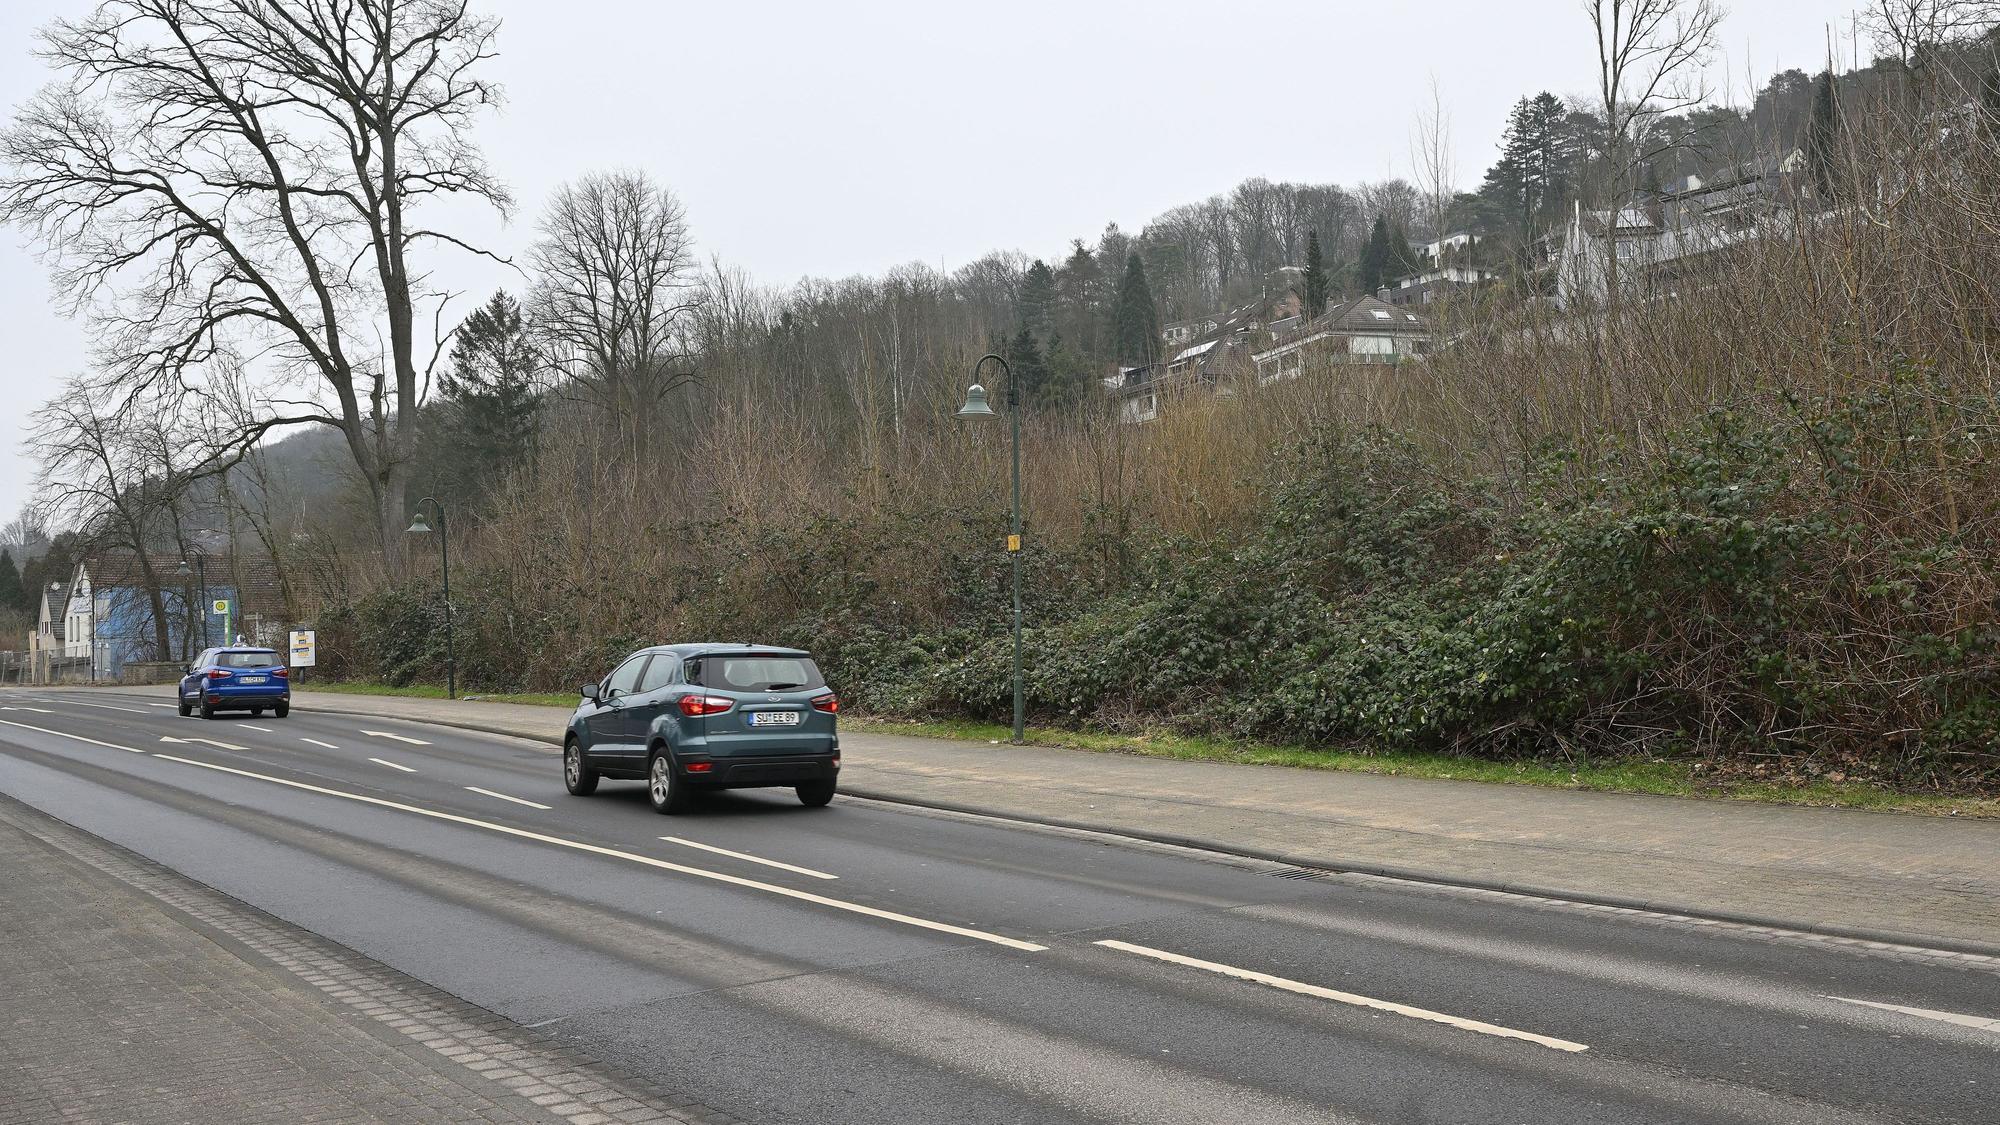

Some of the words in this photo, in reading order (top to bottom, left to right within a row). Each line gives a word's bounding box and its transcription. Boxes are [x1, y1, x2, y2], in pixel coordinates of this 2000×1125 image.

[756, 713, 768, 722] SU
[773, 713, 784, 722] EE
[785, 713, 795, 722] 89
